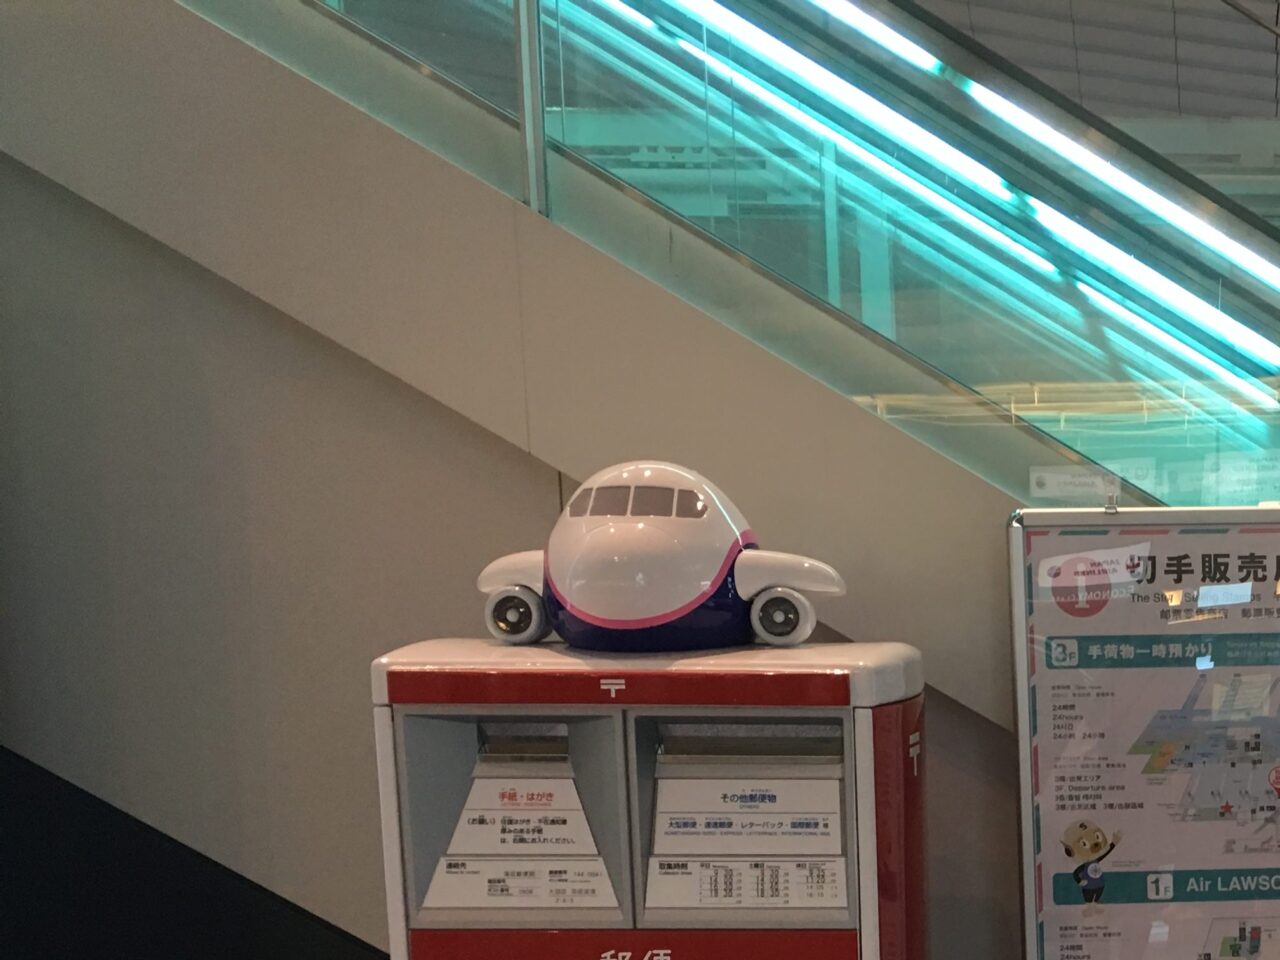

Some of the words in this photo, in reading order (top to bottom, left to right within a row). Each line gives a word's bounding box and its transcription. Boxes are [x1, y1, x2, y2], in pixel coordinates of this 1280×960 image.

[1130, 592, 1151, 604] The
[1087, 641, 1214, 660] 手荷物一時預かり
[498, 791, 555, 803] 手紙・はがき
[720, 793, 777, 804] その他郵便物
[1186, 876, 1211, 893] Air
